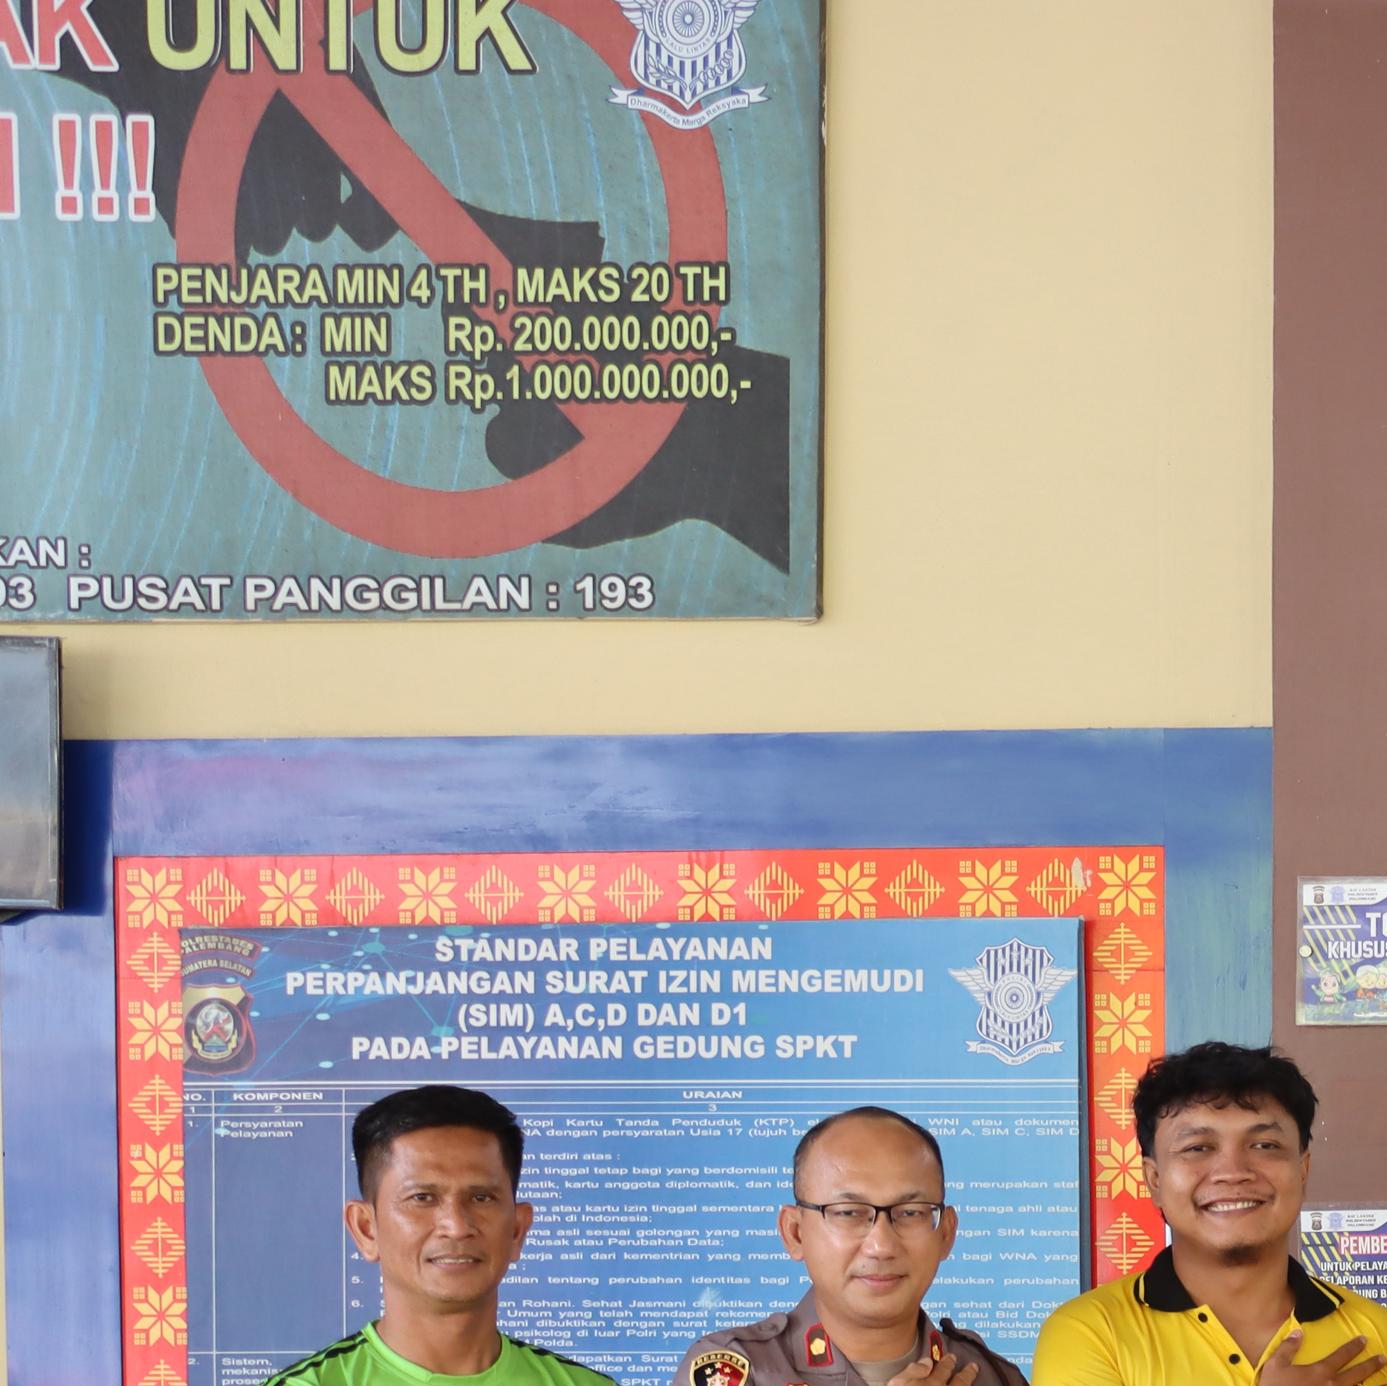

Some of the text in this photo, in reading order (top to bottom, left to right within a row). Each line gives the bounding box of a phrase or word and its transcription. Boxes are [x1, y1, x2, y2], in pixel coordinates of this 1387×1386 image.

[147, 0, 537, 72] UNTUK
[155, 267, 727, 304] PENJARA MIN 4 TH MAKS 20 TH
[323, 317, 387, 352] MIN
[448, 317, 503, 359] Rp.
[515, 317, 732, 358] 200.000.000,-
[329, 365, 432, 401] MAKS
[70, 577, 230, 611] PUSAT
[245, 577, 530, 611] PANGGILAN
[575, 577, 654, 609] 193
[435, 937, 772, 961] STANDAR PELAYANAN
[286, 970, 924, 995] PERPANJANGAN SURAT IZIN MENGEMUDI
[458, 1003, 746, 1032] (SIM) A,C,D DAN D1
[352, 1035, 858, 1060] PADA PELAYANAN GEDUNG SPKT
[233, 1091, 323, 1101] KOMPONEN
[683, 1090, 743, 1099] URAIAN
[220, 1117, 1079, 1129] Persyaratan Kopi Kartu Tanda Penduduk (KTP) WNI atau dokumen
[220, 1127, 1063, 1139] Pelayanan dengan persyaratan Usia 17 (tujuh SIM A, SIM C, SIM
[544, 1166, 778, 1177] tinggal tetap bagi yang berdomisili
[585, 1204, 1042, 1216] kartu izin tinggal sementara tenaga ahli
[1320, 1261, 1353, 1272] UNTUK
[507, 1309, 708, 1320] Umum yang telah mendapat
[514, 1328, 696, 1339] psikolog luar Polri yang
[534, 1338, 578, 1347] Polda.
[641, 1354, 678, 1363] Surat
[621, 1378, 661, 1386] SPKT
